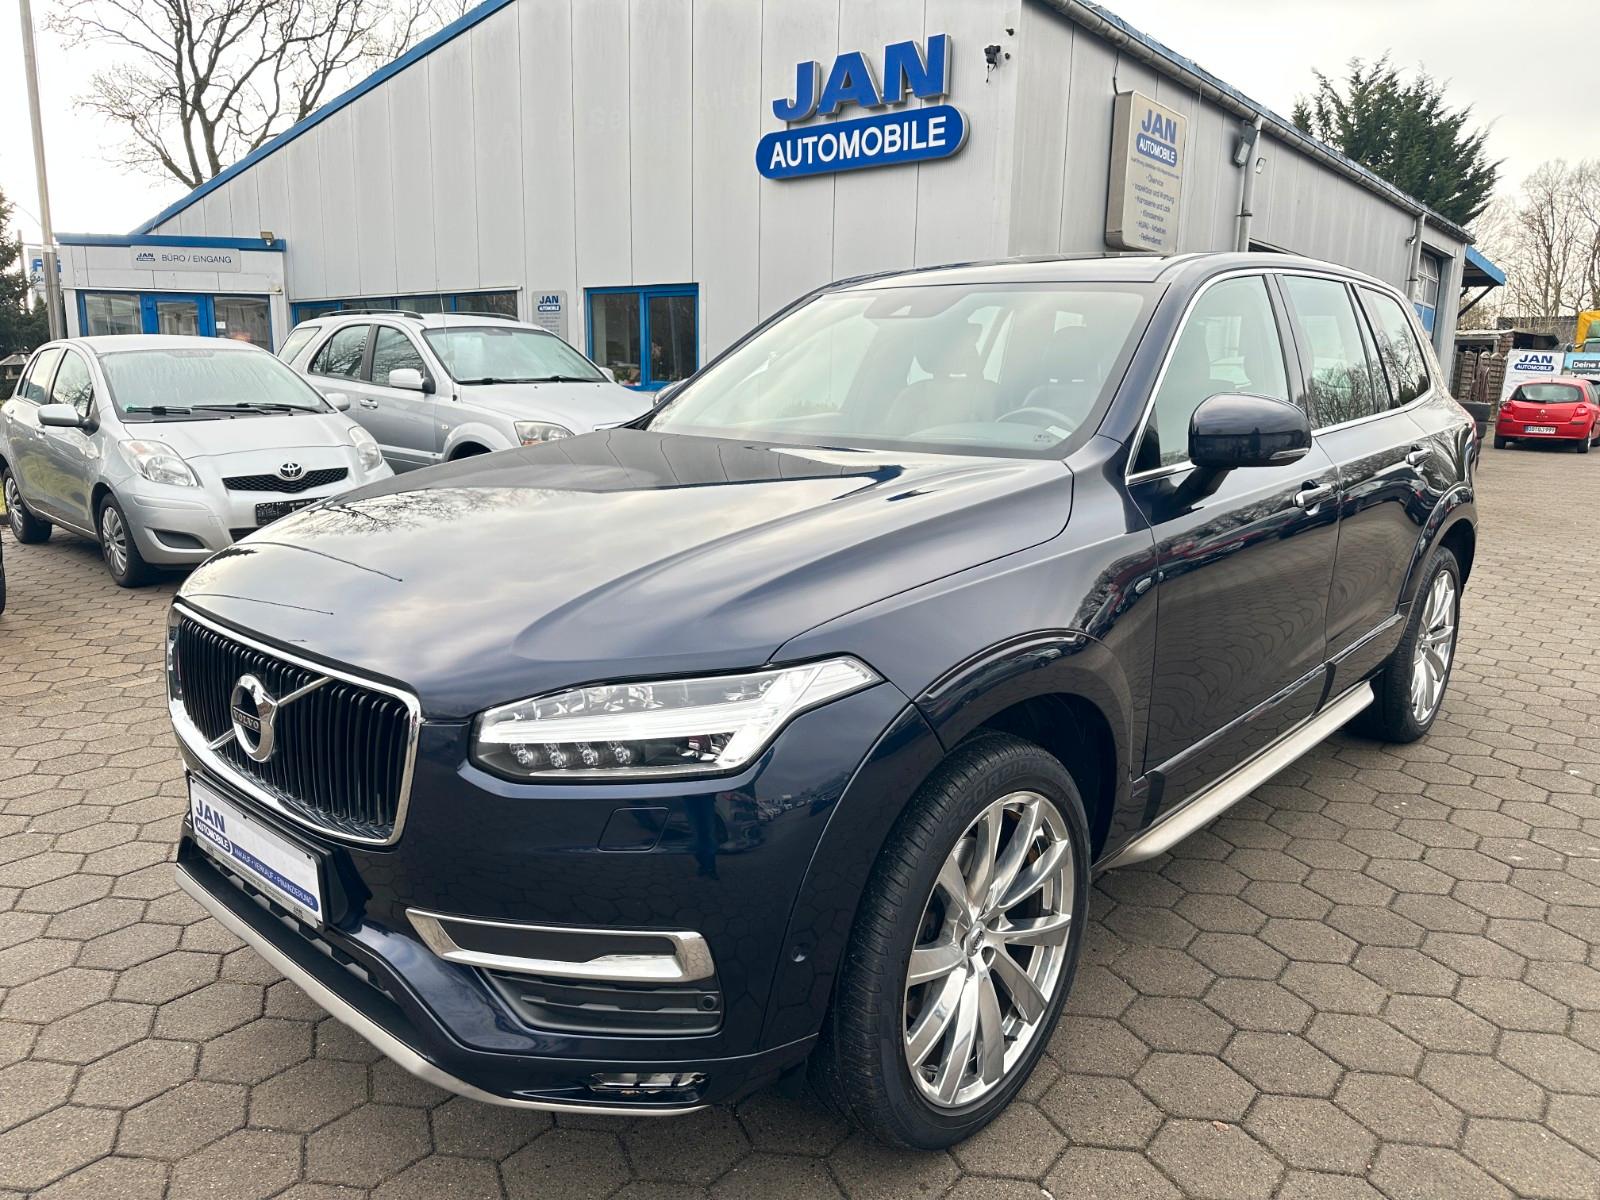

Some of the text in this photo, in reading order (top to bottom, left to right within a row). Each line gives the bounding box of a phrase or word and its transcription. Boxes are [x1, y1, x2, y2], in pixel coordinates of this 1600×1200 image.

[772, 33, 951, 122] JAN
[1141, 109, 1177, 145] JAN
[769, 115, 947, 170] AUTOMOBILE
[1138, 138, 1175, 164] AUTOMOBILE
[161, 252, 186, 262] BÜRO
[193, 254, 232, 264] EINGANG
[539, 295, 559, 304] JAN
[1516, 363, 1552, 371] AUTOMOBILE
[1519, 354, 1553, 364] JAN
[233, 710, 259, 729] VOLVO
[195, 799, 226, 834] JAN
[196, 821, 230, 850] AUTOMOBILE
